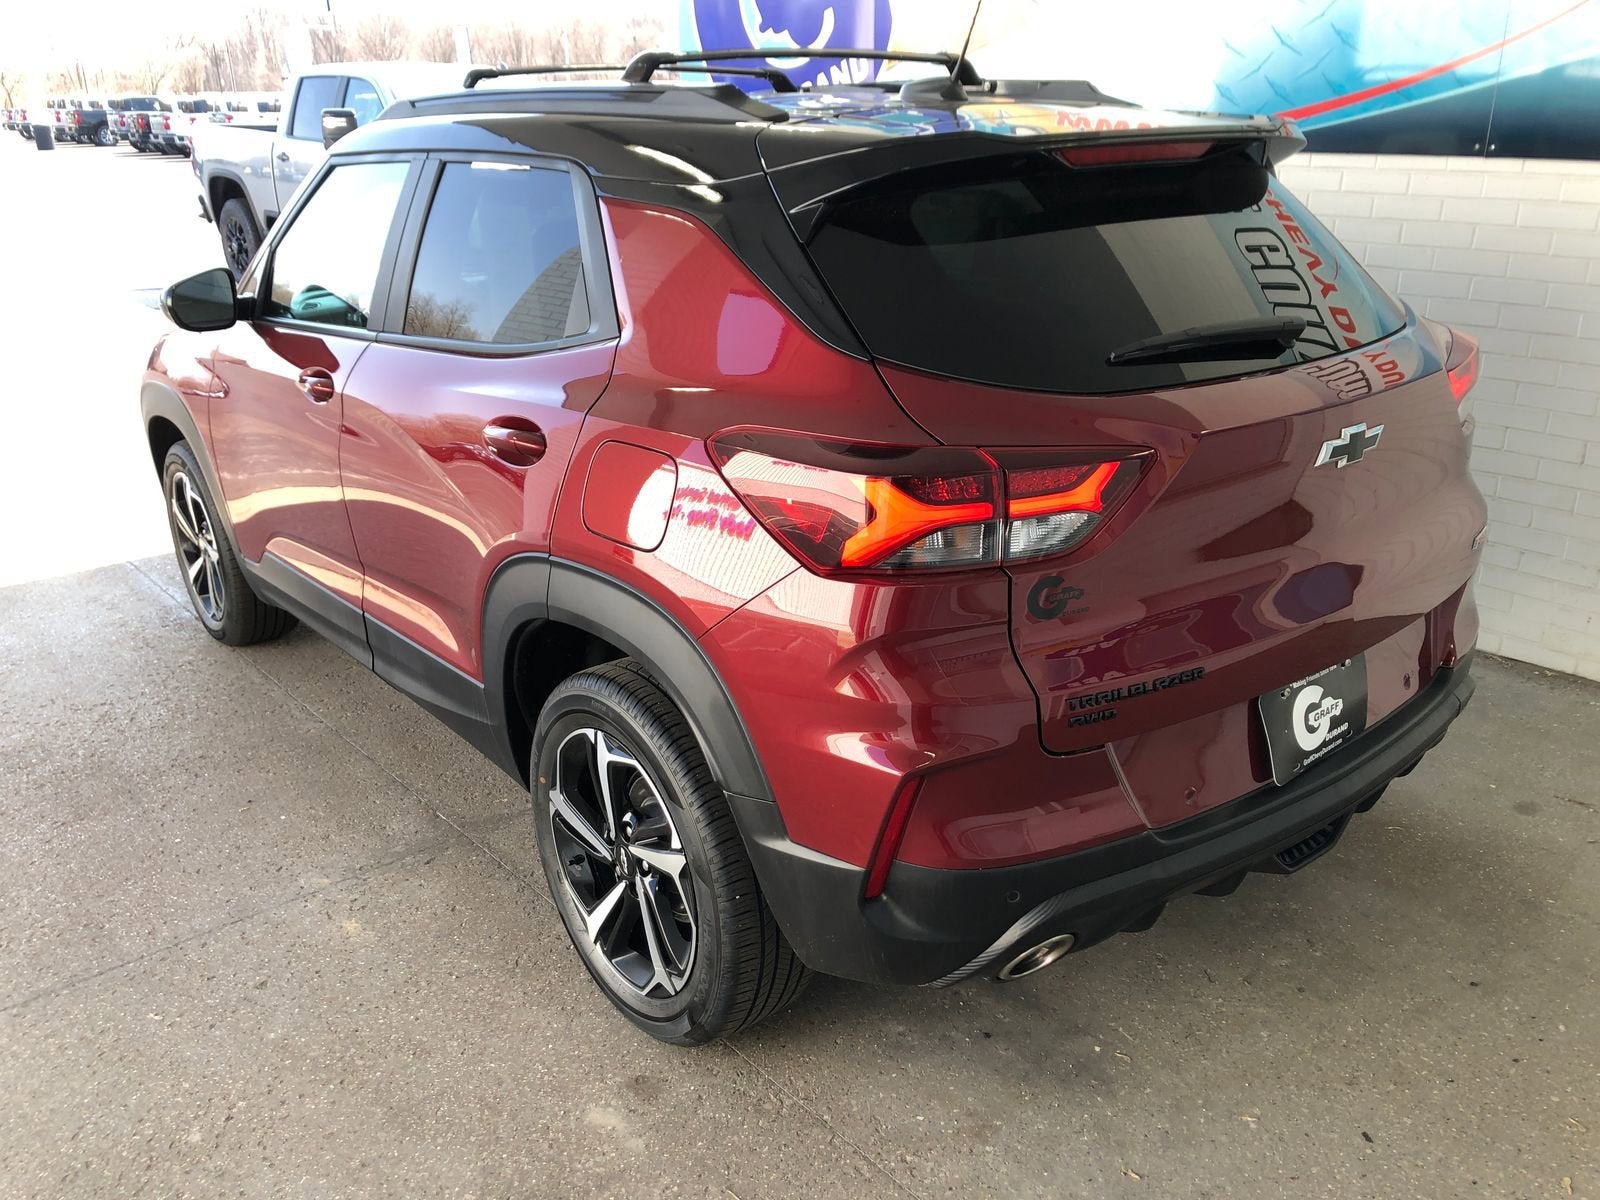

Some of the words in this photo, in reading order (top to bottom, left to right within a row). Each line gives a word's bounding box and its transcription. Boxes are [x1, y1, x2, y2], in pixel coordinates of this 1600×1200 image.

[1065, 667, 1206, 711] TRAILBLAZER
[1313, 701, 1340, 722] GRAFF
[1325, 722, 1349, 741] DURAND
